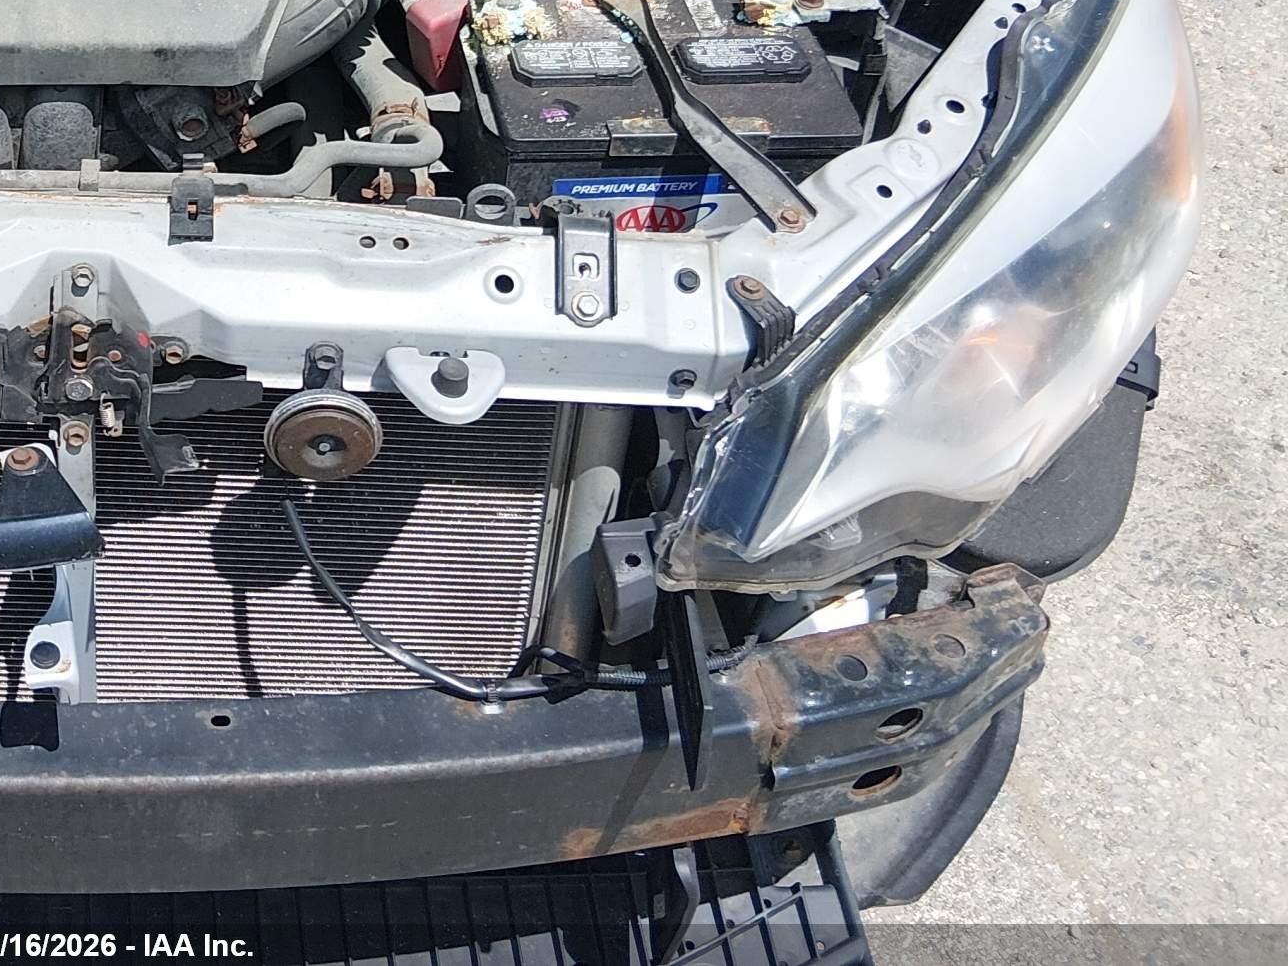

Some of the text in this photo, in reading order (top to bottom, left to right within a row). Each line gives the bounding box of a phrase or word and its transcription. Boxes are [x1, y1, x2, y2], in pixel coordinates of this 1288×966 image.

[571, 181, 699, 195] PREMIUM BATTERY
[619, 206, 683, 232] AAA
